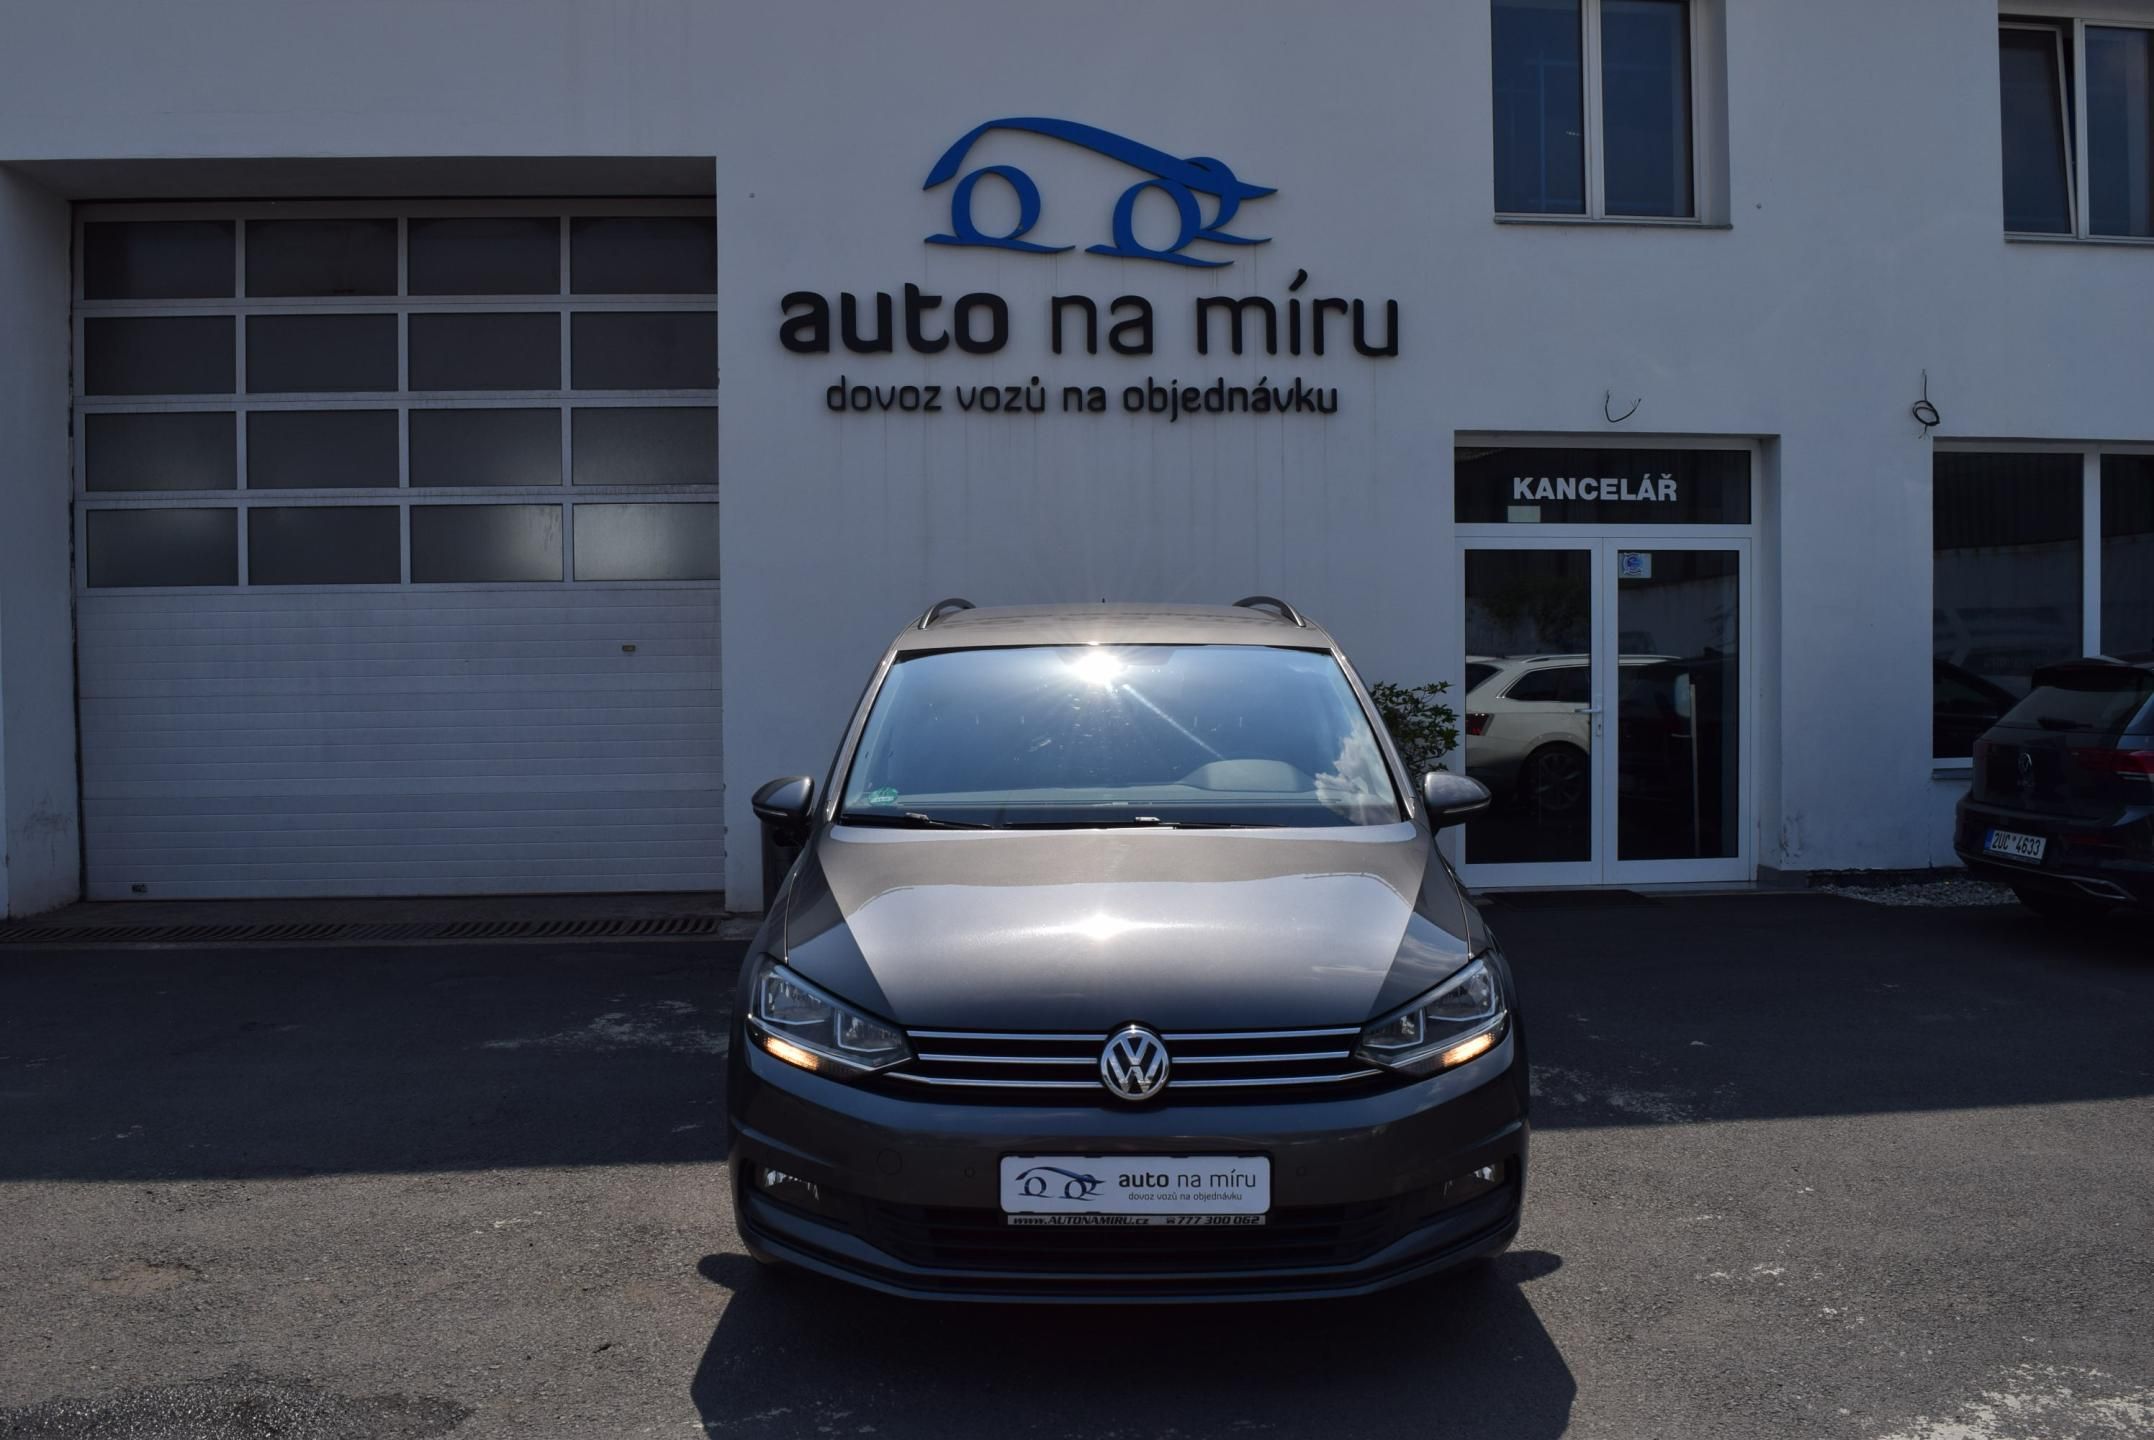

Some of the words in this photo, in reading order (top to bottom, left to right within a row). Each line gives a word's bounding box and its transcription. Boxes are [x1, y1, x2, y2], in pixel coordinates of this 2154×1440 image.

[779, 282, 1009, 355] auto
[1051, 294, 1153, 355] na
[1195, 269, 1398, 357] míru
[826, 376, 942, 413] dovoz
[956, 376, 1046, 413] vozů
[1063, 379, 1106, 413] na
[1122, 376, 1338, 423] objednávku
[1513, 473, 1677, 502] KANCELÁŘ
[1992, 832, 2011, 850] 2UC
[2015, 836, 2041, 856] 4633
[1118, 1171, 1169, 1188] auto
[1177, 1174, 1201, 1188] na
[1209, 1168, 1256, 1188] míru
[1128, 1192, 1154, 1201] dovoz
[1156, 1192, 1178, 1201] vozů
[1180, 1193, 1190, 1201] na
[1193, 1192, 1242, 1202] objednávku
[1178, 1216, 1202, 1225] 777
[1204, 1216, 1231, 1225] 300
[1233, 1216, 1260, 1225] 062
